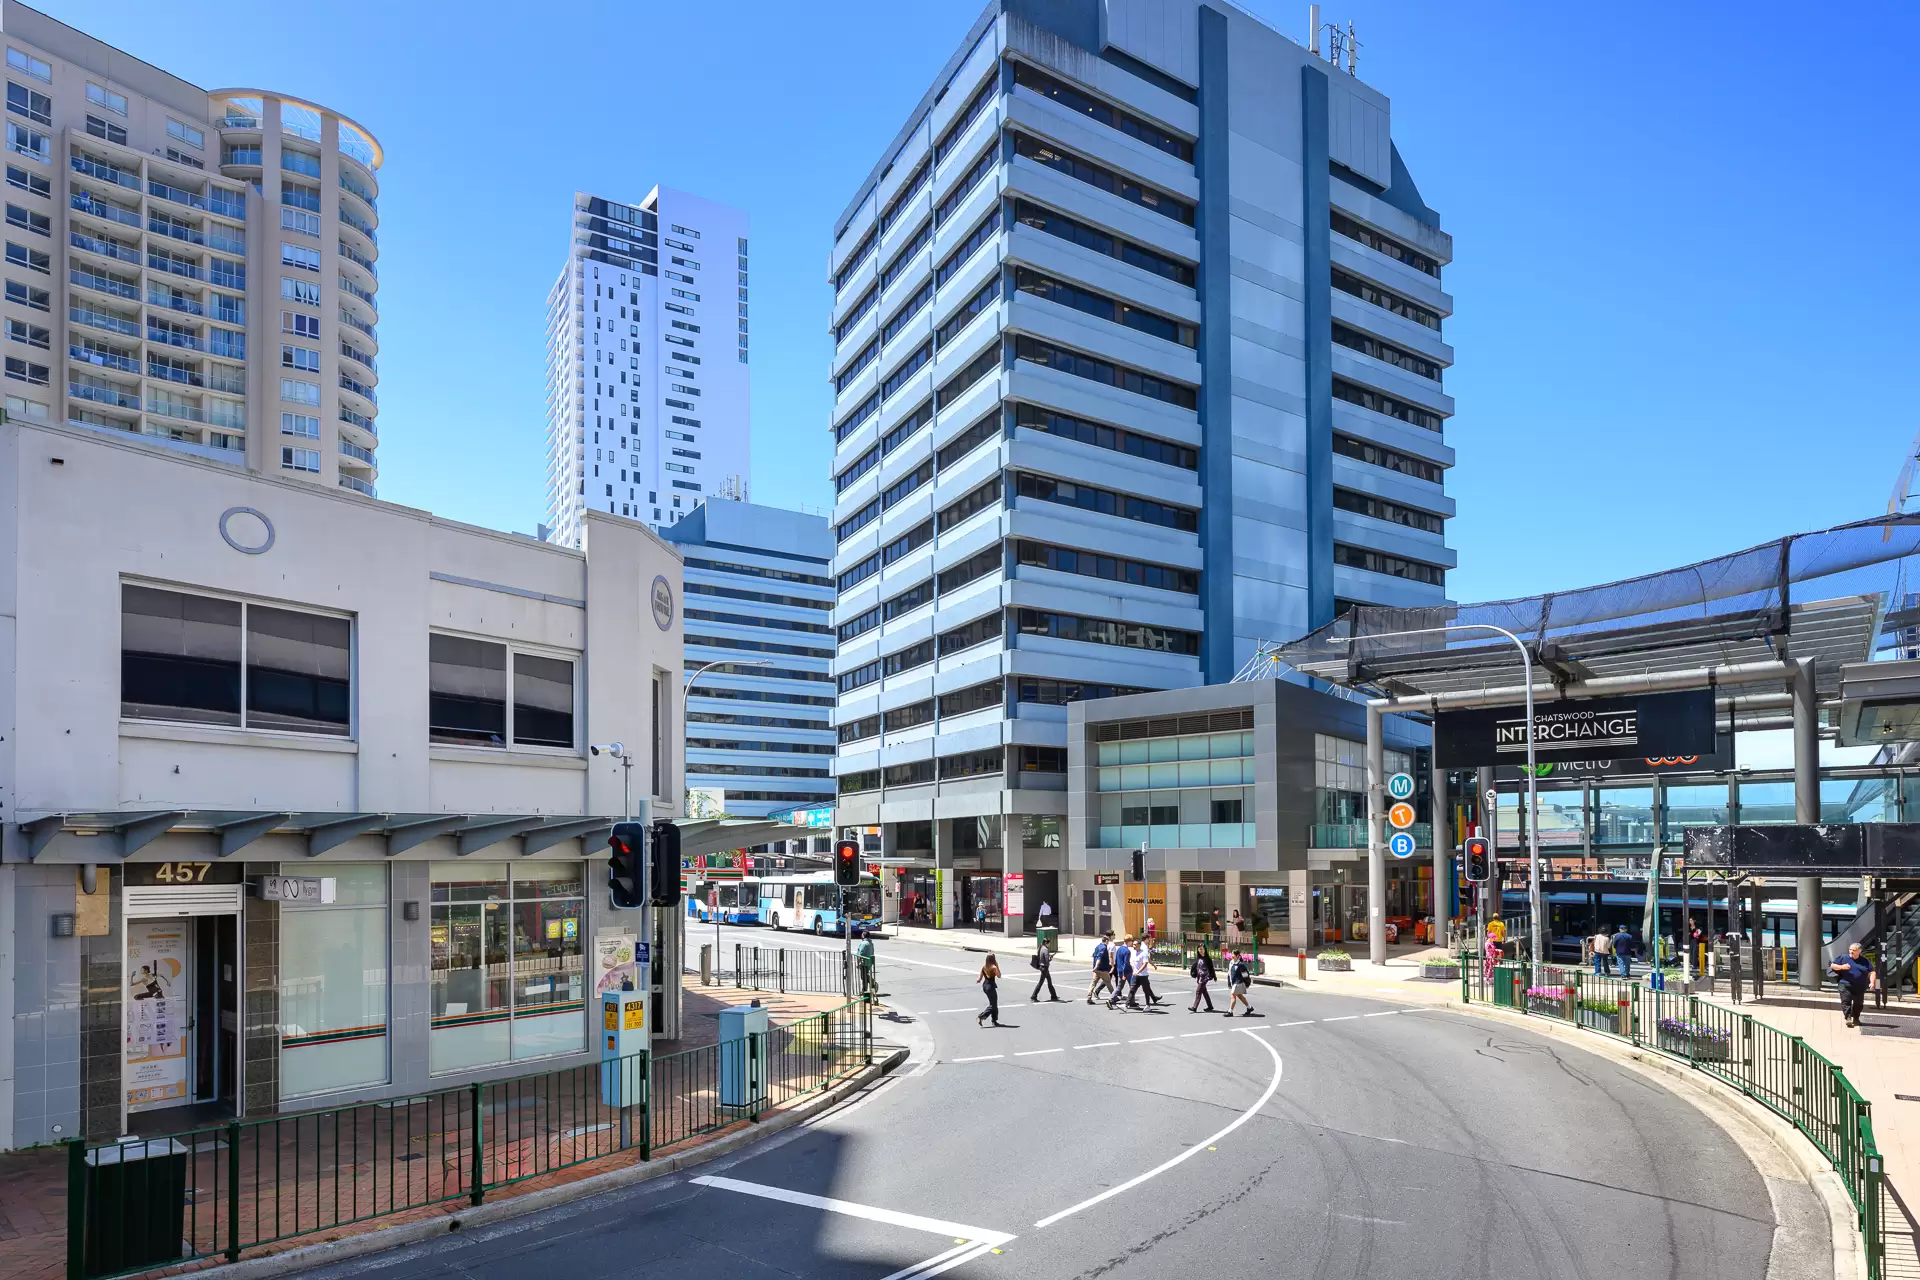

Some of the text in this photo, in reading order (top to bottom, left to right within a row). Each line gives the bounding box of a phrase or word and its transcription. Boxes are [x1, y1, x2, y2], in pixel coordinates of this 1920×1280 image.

[1534, 711, 1595, 723] CHATSWOOD
[1394, 779, 1408, 793] M
[1394, 808, 1406, 823] T
[1397, 838, 1408, 853] B
[155, 862, 212, 883] 457
[1615, 869, 1637, 877] Railway
[626, 1001, 642, 1011] 4317
